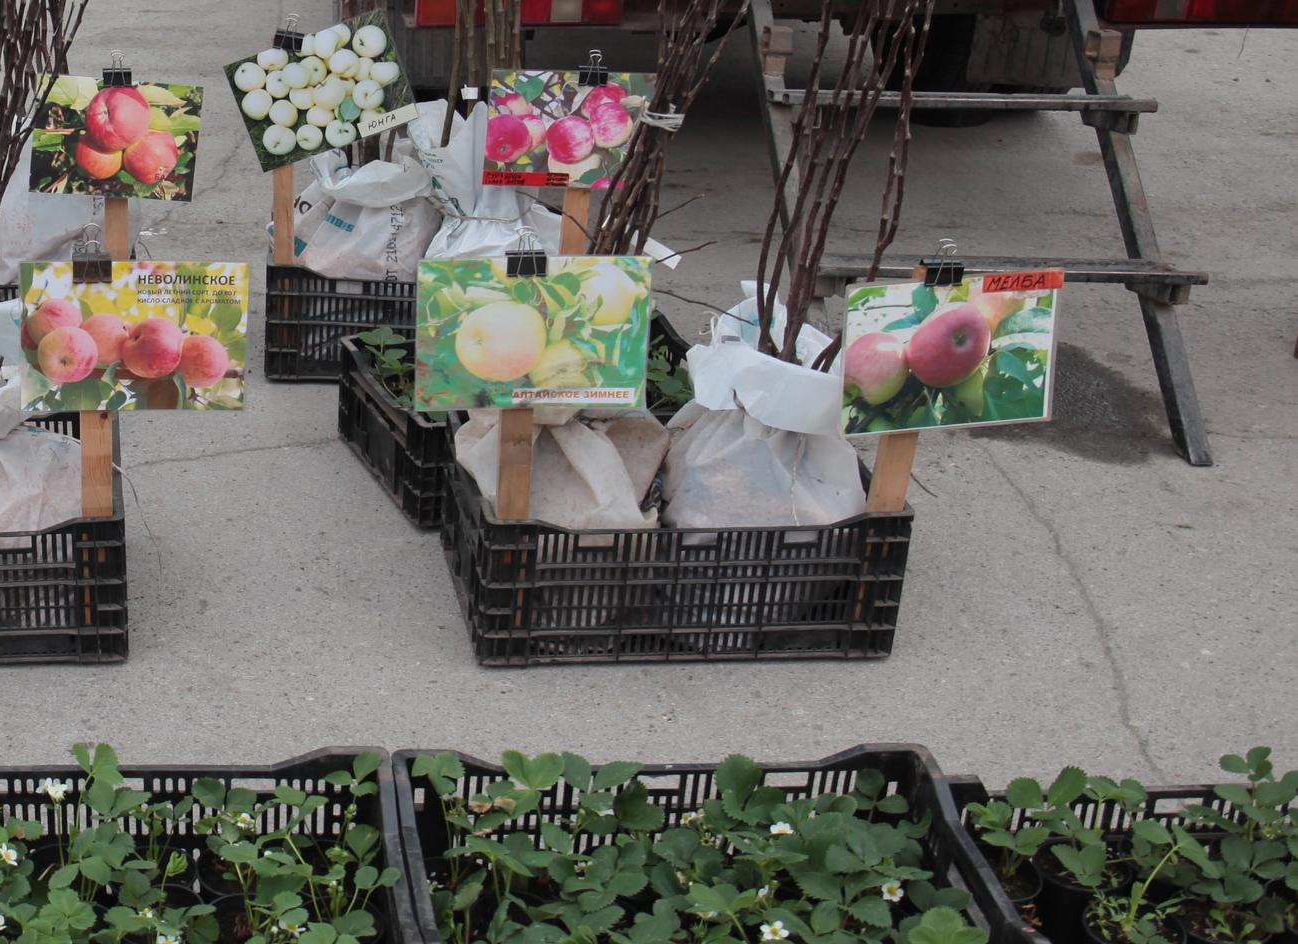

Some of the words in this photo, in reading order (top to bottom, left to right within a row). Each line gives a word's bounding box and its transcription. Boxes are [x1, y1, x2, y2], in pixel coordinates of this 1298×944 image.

[368, 114, 396, 130] ЮНГА
[138, 274, 235, 285] НЕВОЛИНСКОЕ
[987, 274, 1046, 290] МЕЛБА
[512, 389, 580, 399] АЛТАЙСКОЕ
[583, 390, 630, 399] ЗИМНЕЕ
